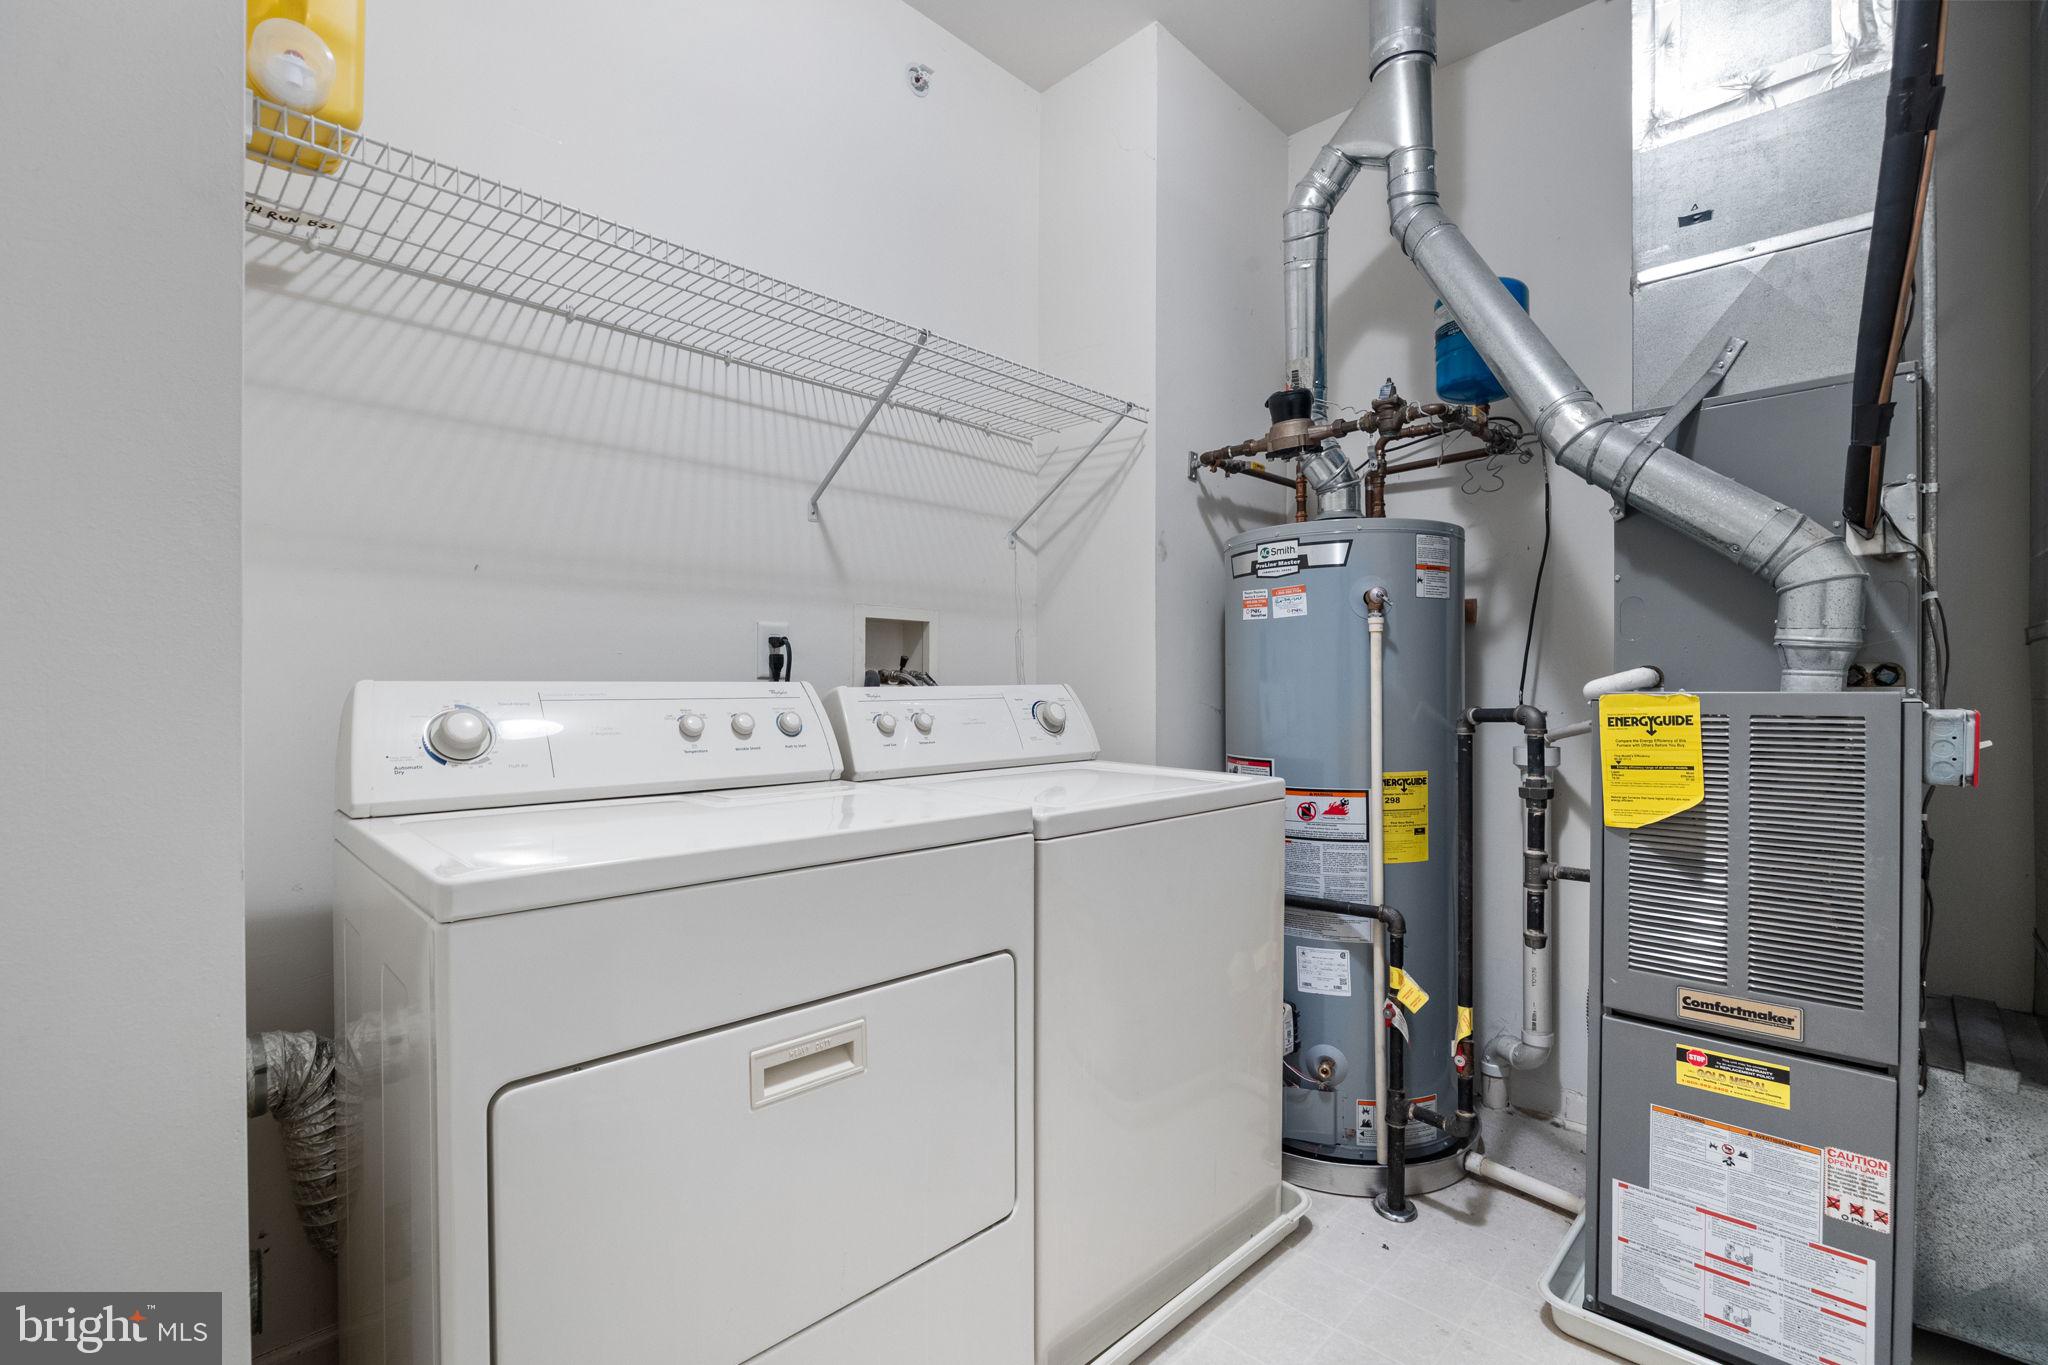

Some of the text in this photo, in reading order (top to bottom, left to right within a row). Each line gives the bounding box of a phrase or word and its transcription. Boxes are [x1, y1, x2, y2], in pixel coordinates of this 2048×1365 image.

[266, 211, 300, 223] RUN
[1270, 546, 1296, 556] Smith
[1608, 715, 1694, 731] ENERGYGUIDE
[1382, 778, 1427, 789] NERGYGUIDE
[1682, 996, 1795, 1025] Comfortmaker
[1688, 1054, 1706, 1062] STOP
[1720, 1066, 1756, 1076] REPLACEMENT
[1745, 1067, 1773, 1076] WARRANTY
[1697, 1069, 1726, 1081] GOLD
[1729, 1076, 1768, 1091] MEDAL
[1680, 1113, 1706, 1124] WARNING
[1827, 1148, 1888, 1171] CAUTION
[1828, 1158, 1888, 1179] OPEN FLAME!
